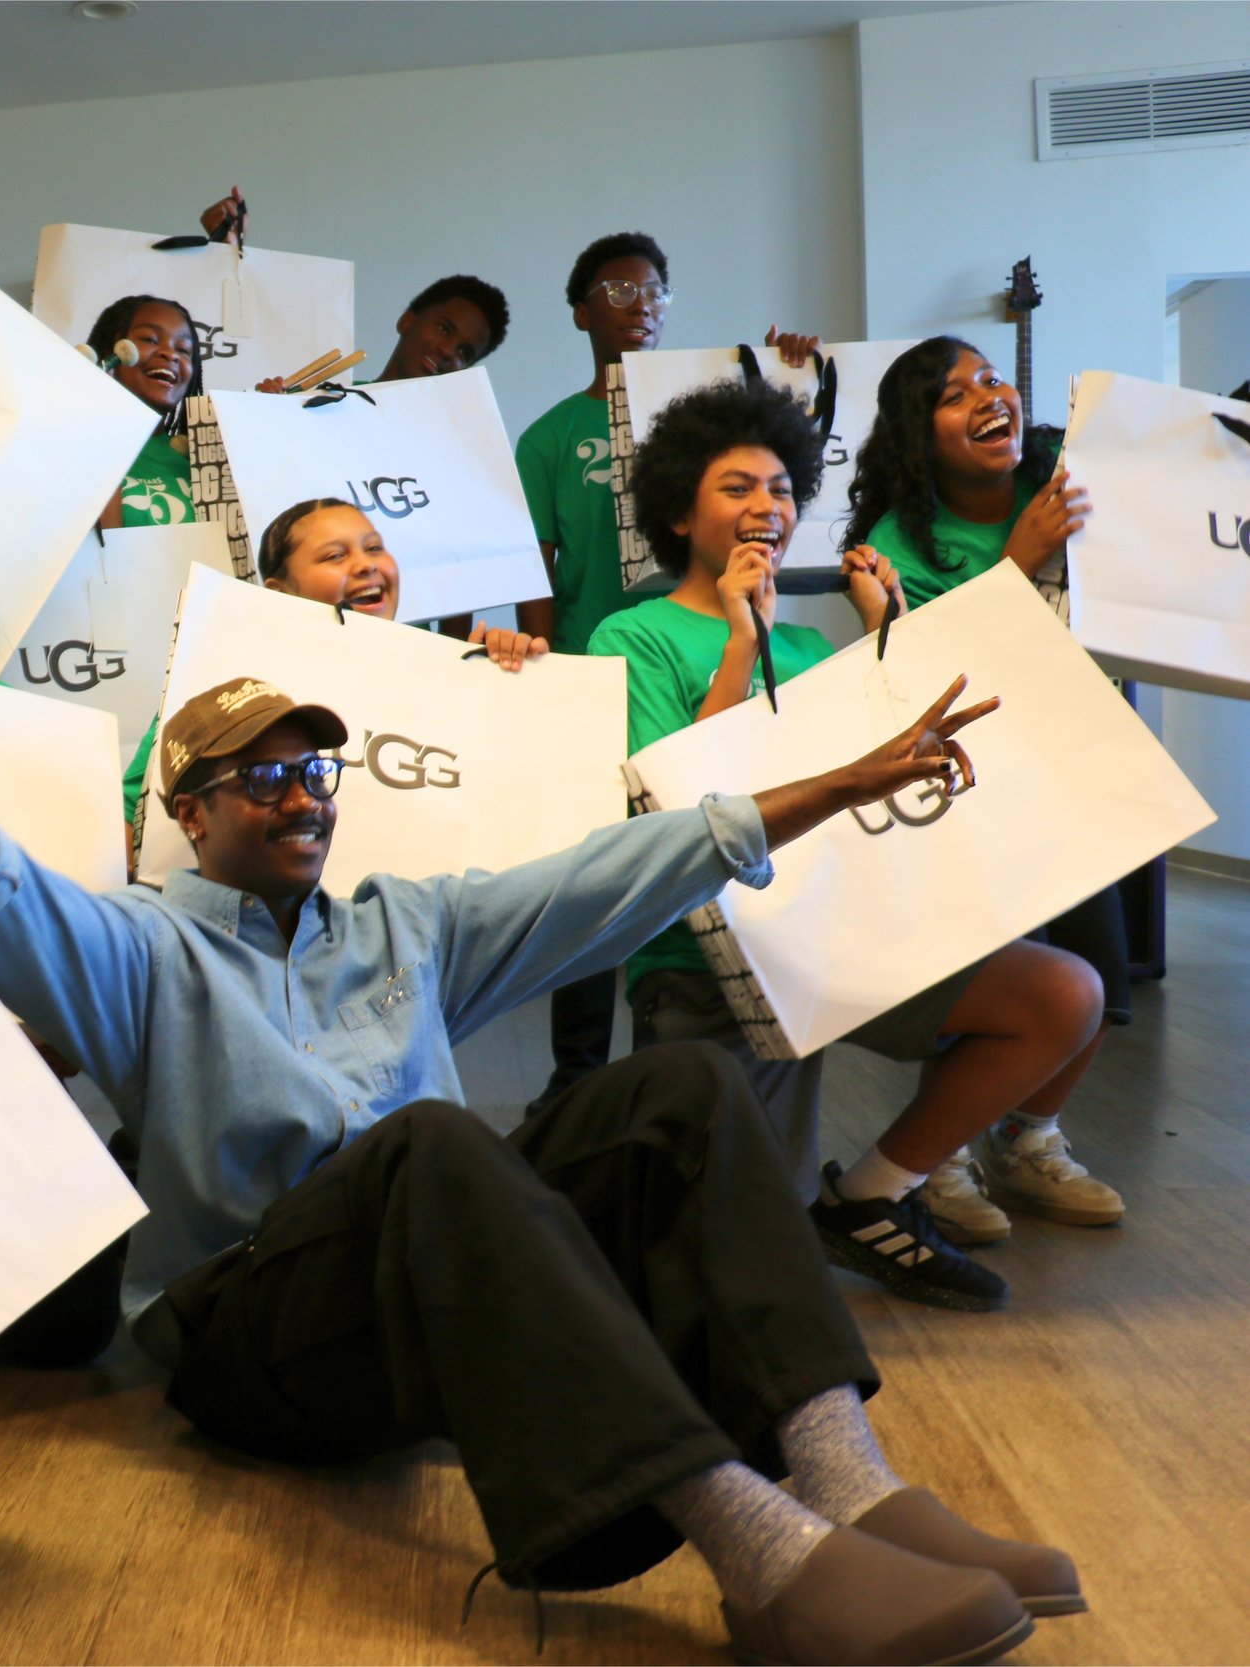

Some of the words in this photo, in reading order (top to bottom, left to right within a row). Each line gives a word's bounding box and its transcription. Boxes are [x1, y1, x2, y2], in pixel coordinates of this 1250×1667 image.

[191, 320, 239, 361] GG
[576, 438, 613, 488] 2
[345, 476, 430, 520] UGG
[17, 638, 127, 693] UGG
[331, 728, 461, 790] UGG
